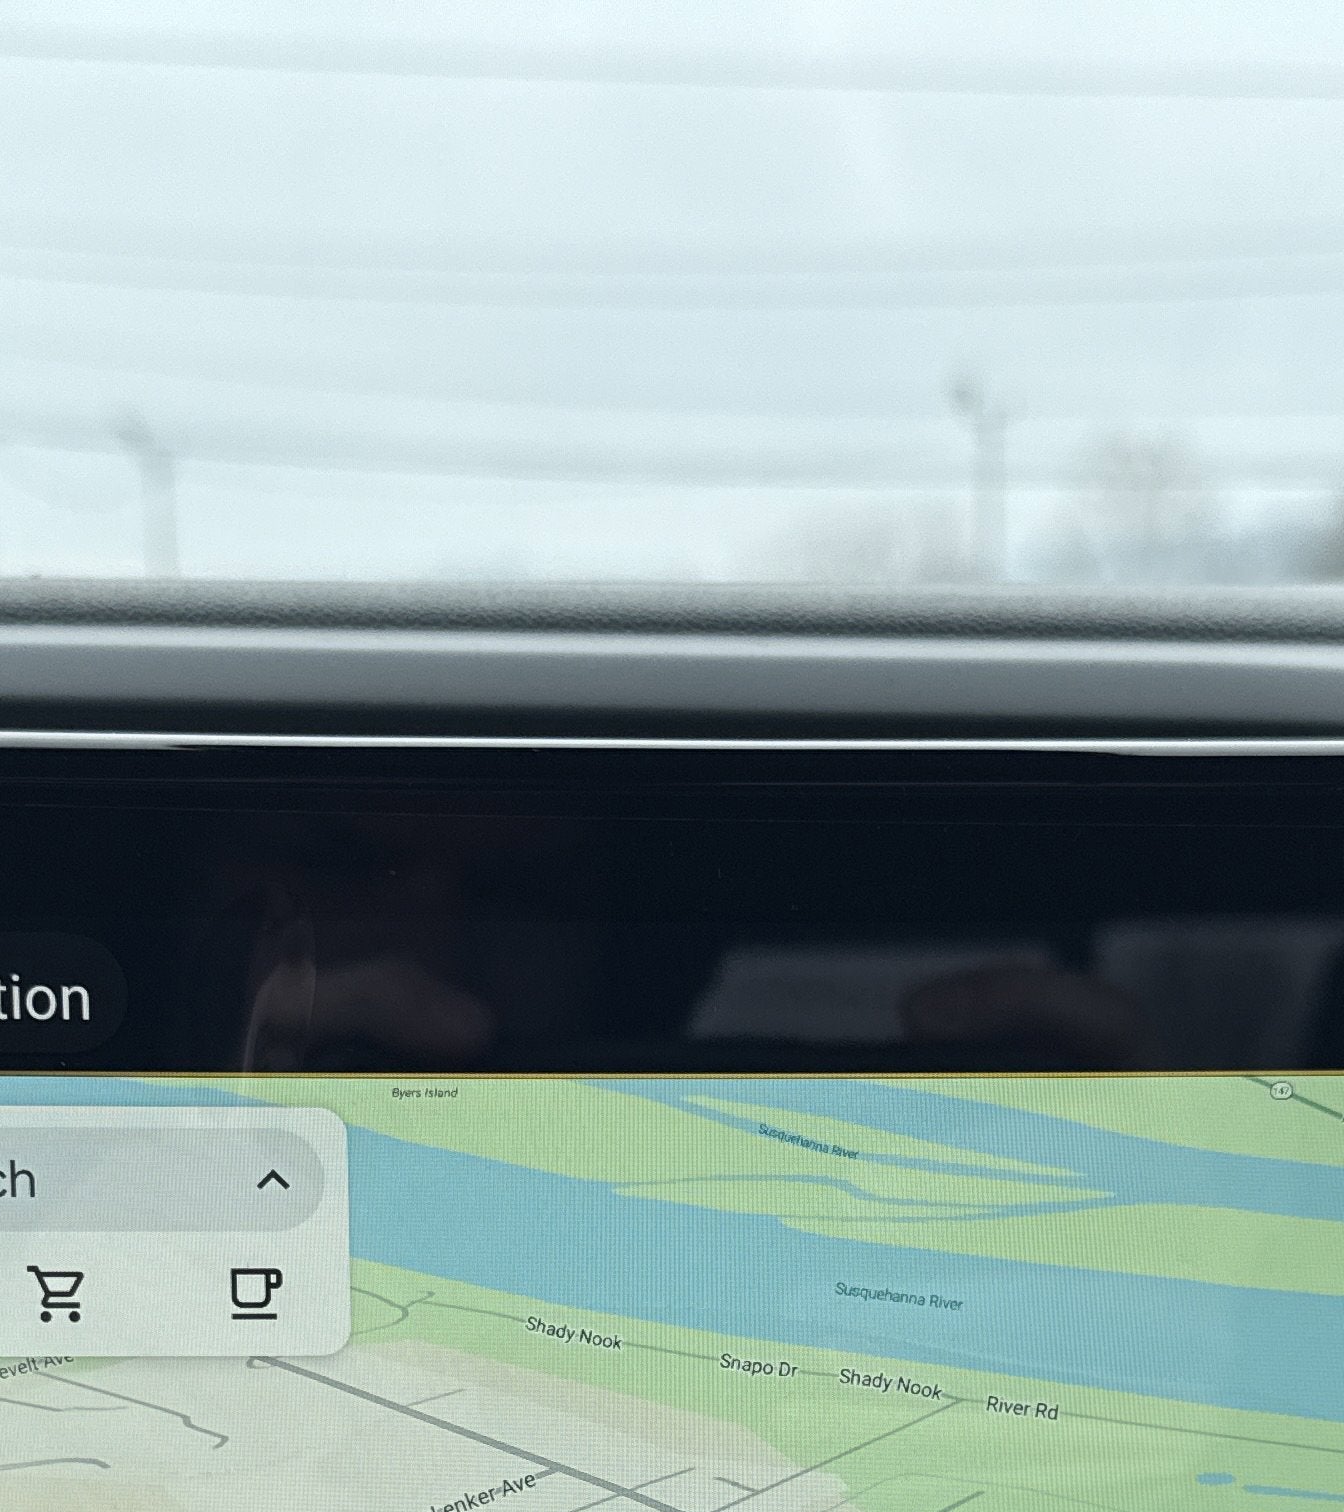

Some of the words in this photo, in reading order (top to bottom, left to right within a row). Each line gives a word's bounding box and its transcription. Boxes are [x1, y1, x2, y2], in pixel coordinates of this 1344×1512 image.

[392, 1087, 422, 1100] Byers
[424, 1087, 459, 1098] Island
[758, 1123, 829, 1154] Susquehanna
[831, 1144, 860, 1160] River
[834, 1282, 926, 1306] Susquehanna
[929, 1294, 964, 1311] River
[524, 1316, 576, 1344] Shady
[579, 1329, 623, 1351] Nook
[719, 1353, 774, 1377] Snapo
[778, 1361, 799, 1378] Dr
[839, 1368, 894, 1393] Shady
[896, 1377, 943, 1401] Nook
[986, 1395, 1031, 1417] River
[1034, 1402, 1060, 1421] Rd
[501, 1473, 537, 1498] Ave
